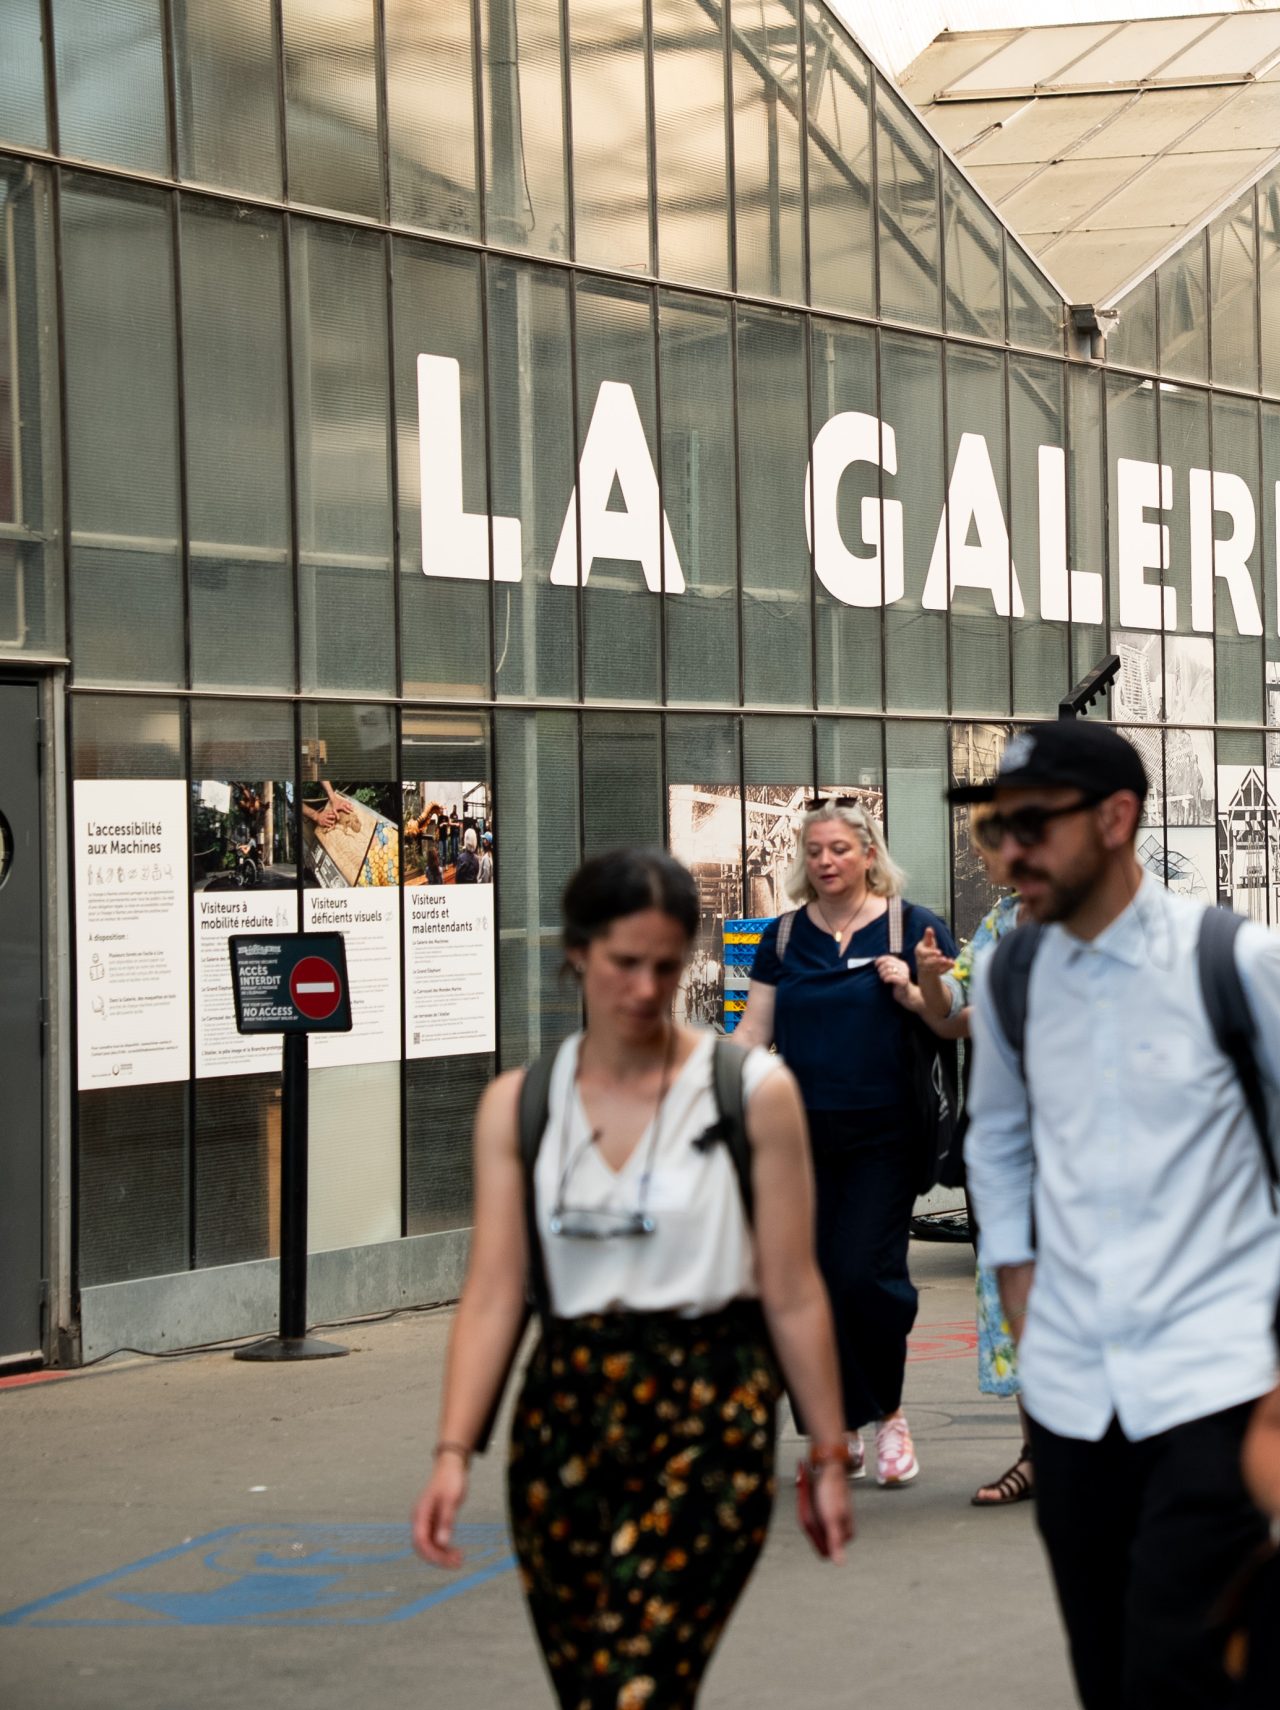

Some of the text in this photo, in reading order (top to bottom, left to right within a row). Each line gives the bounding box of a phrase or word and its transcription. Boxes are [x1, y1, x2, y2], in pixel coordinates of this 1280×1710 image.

[417, 353, 686, 594] LA
[88, 821, 162, 836] L'accessibilité
[88, 840, 161, 854] aux Machines
[311, 897, 347, 909] Visiteurs
[411, 894, 446, 905] Visiteurs
[201, 901, 247, 914] Visiteurs à
[412, 908, 449, 920] sourds et
[201, 915, 273, 929] mobilité réduite
[311, 911, 382, 924] déficients visuels
[412, 921, 472, 934] malentendants
[239, 964, 268, 976] ACCÈS
[240, 976, 281, 986] INTERDIT
[243, 1007, 293, 1017] NO ACCESS
